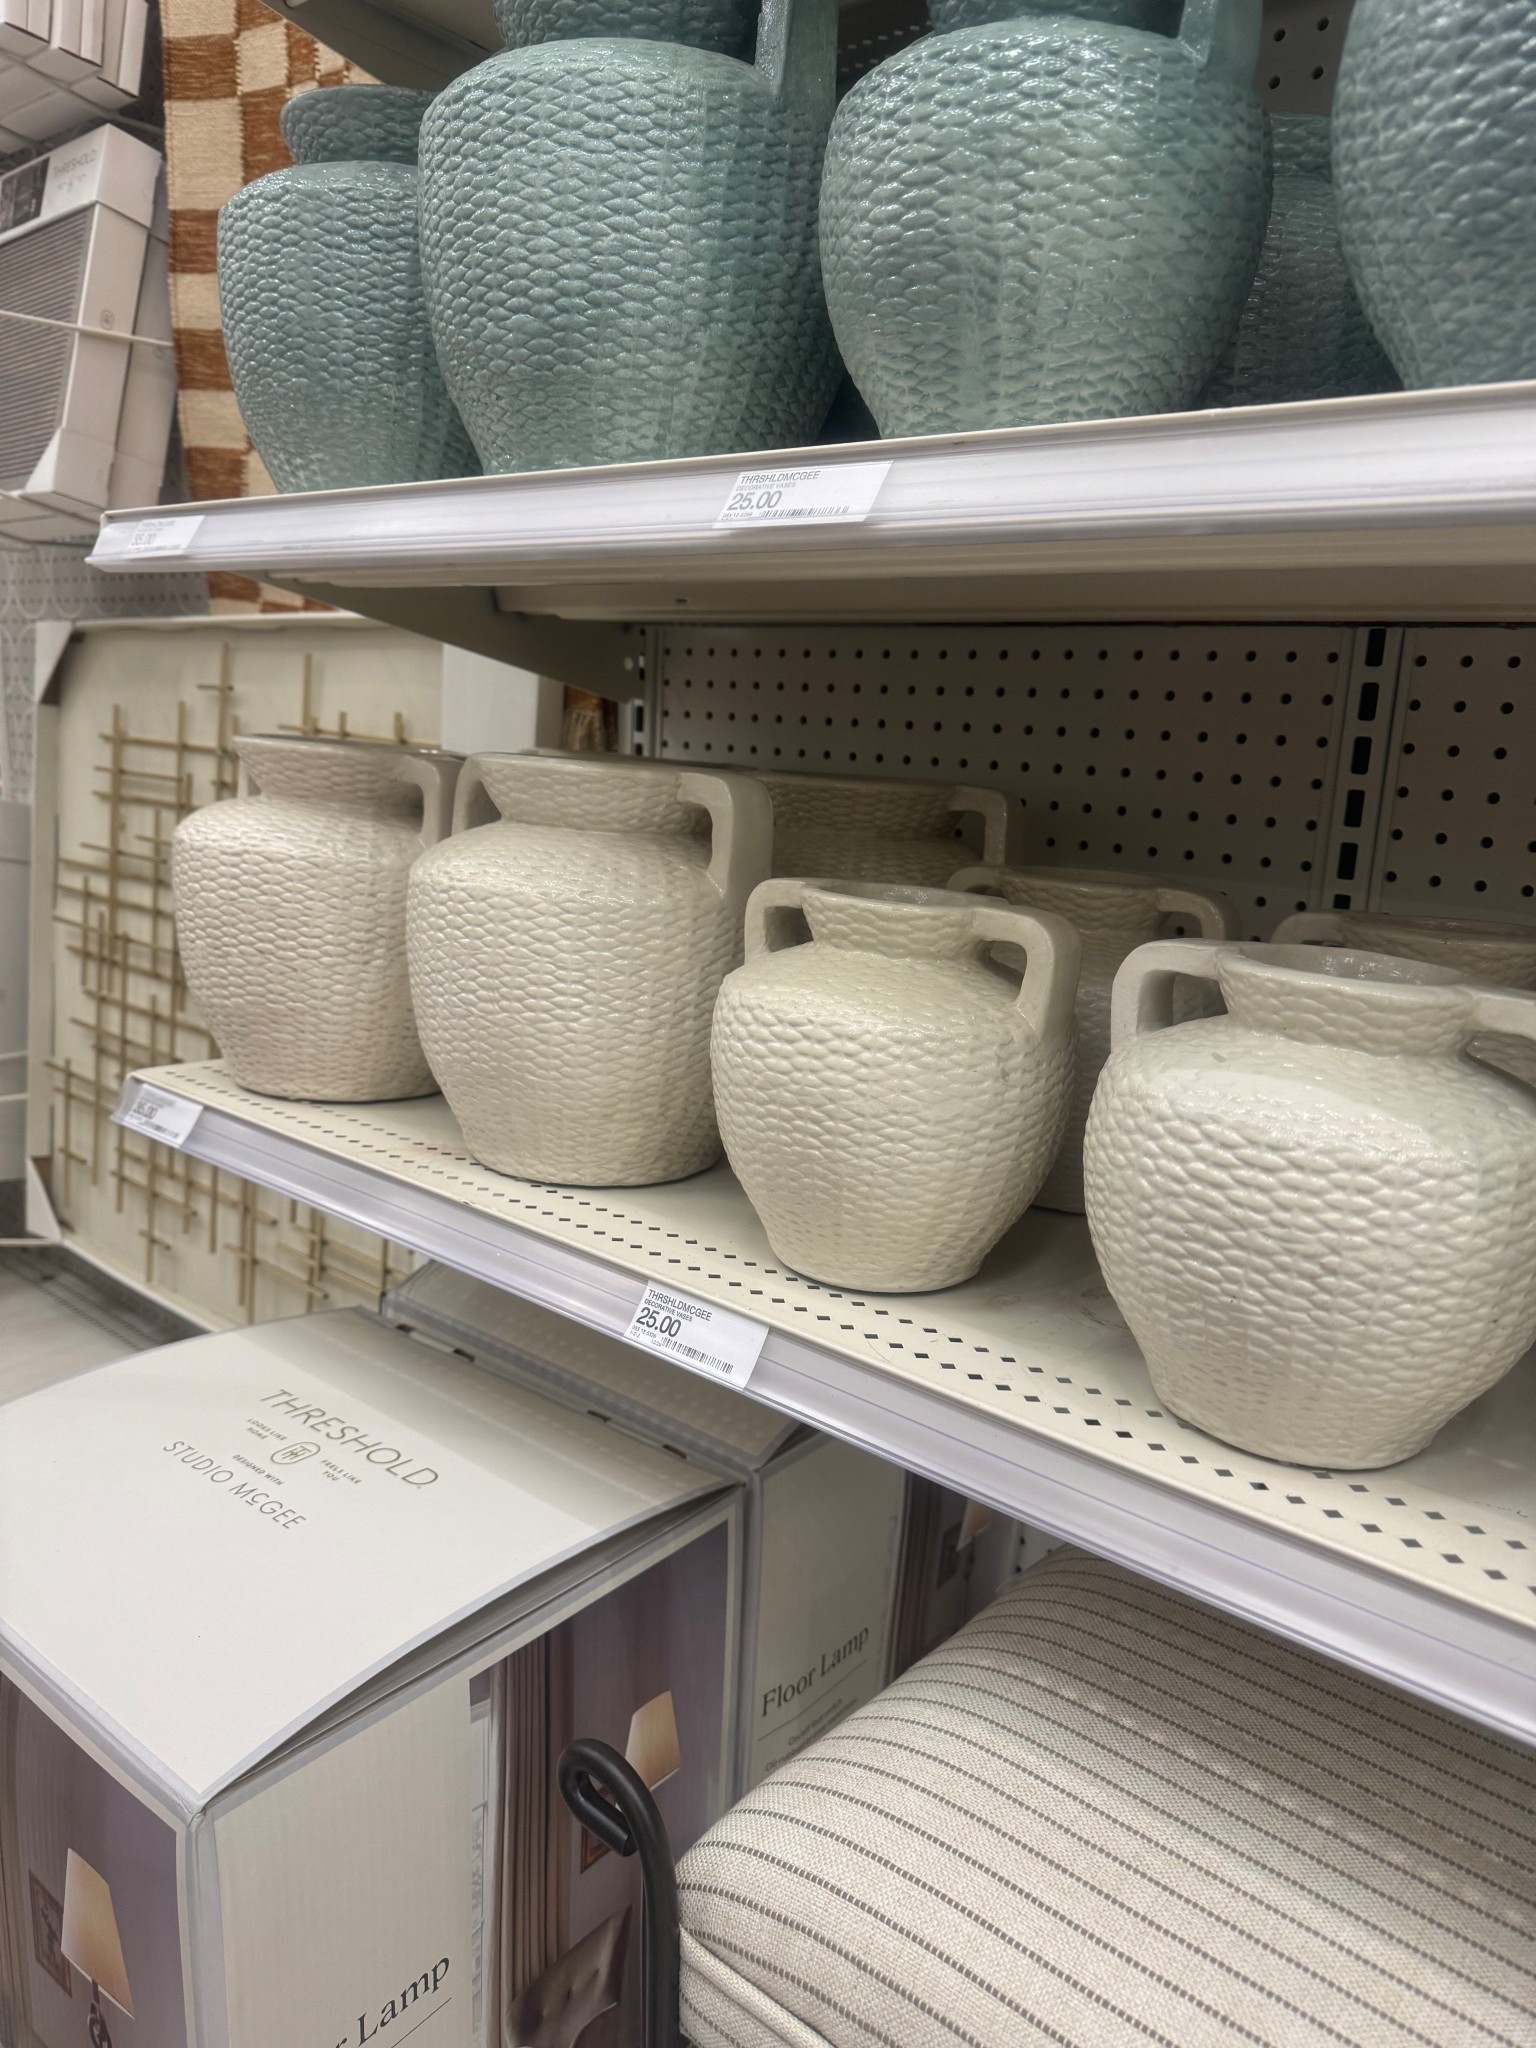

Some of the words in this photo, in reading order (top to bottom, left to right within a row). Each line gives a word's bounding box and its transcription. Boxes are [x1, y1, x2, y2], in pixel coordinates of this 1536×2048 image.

[736, 483, 775, 492] DECORATIVE
[740, 471, 821, 485] THRSHLDMCGEE
[727, 490, 783, 511] 25.00
[644, 1298, 676, 1315] DECORATIVE
[676, 1310, 693, 1322] VASES
[648, 1289, 713, 1322] THRSHLDMCGEE
[635, 1306, 682, 1338] 25.00
[246, 1426, 268, 1440] HOME
[248, 1418, 272, 1435] LOOKS
[269, 1427, 288, 1441] LIKE
[260, 1388, 439, 1486] THRESHOLD
[163, 1440, 234, 1484] STUDIO
[232, 1454, 266, 1476] DESIGNED
[263, 1471, 285, 1487] WITH
[320, 1458, 345, 1475] FEELS
[343, 1470, 362, 1485] LIKE
[323, 1470, 340, 1482] YOU
[761, 1666, 817, 1718] Floor
[820, 1627, 870, 1678] Lamp
[357, 1957, 450, 2048] Lamp
